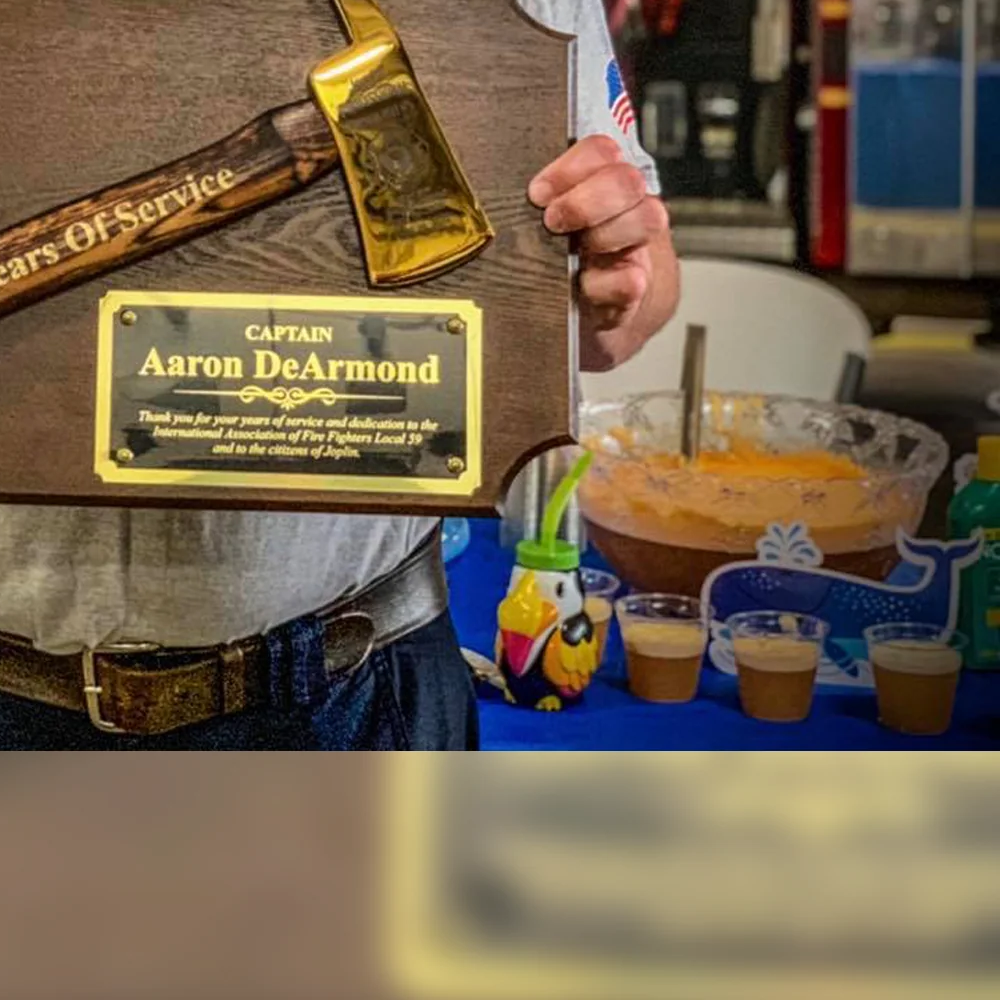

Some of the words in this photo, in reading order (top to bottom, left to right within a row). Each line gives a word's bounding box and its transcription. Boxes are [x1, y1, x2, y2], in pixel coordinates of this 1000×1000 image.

[65, 211, 111, 251] Of
[114, 168, 236, 232] Service
[245, 324, 332, 343] CAPTAIN
[138, 347, 243, 378] Aaron
[253, 350, 441, 384] DeArmond
[139, 410, 171, 424] Thank
[171, 414, 193, 425] you
[193, 412, 212, 426] for
[212, 415, 239, 428] your
[239, 416, 270, 428] years
[272, 414, 286, 429] of
[286, 416, 324, 428] service
[325, 417, 347, 428] and
[348, 417, 405, 430] dedication
[407, 419, 418, 430] to
[420, 418, 438, 431] the
[153, 425, 224, 439] International
[224, 428, 286, 441] Association
[288, 430, 302, 443] of
[302, 430, 325, 442] Fire
[327, 431, 372, 445] Fighters
[374, 432, 405, 444] Local
[212, 442, 235, 454] and
[235, 444, 247, 454] to
[248, 442, 267, 455] the
[268, 444, 308, 456] citizens
[310, 445, 324, 459] of
[323, 446, 360, 460] Joplin.
